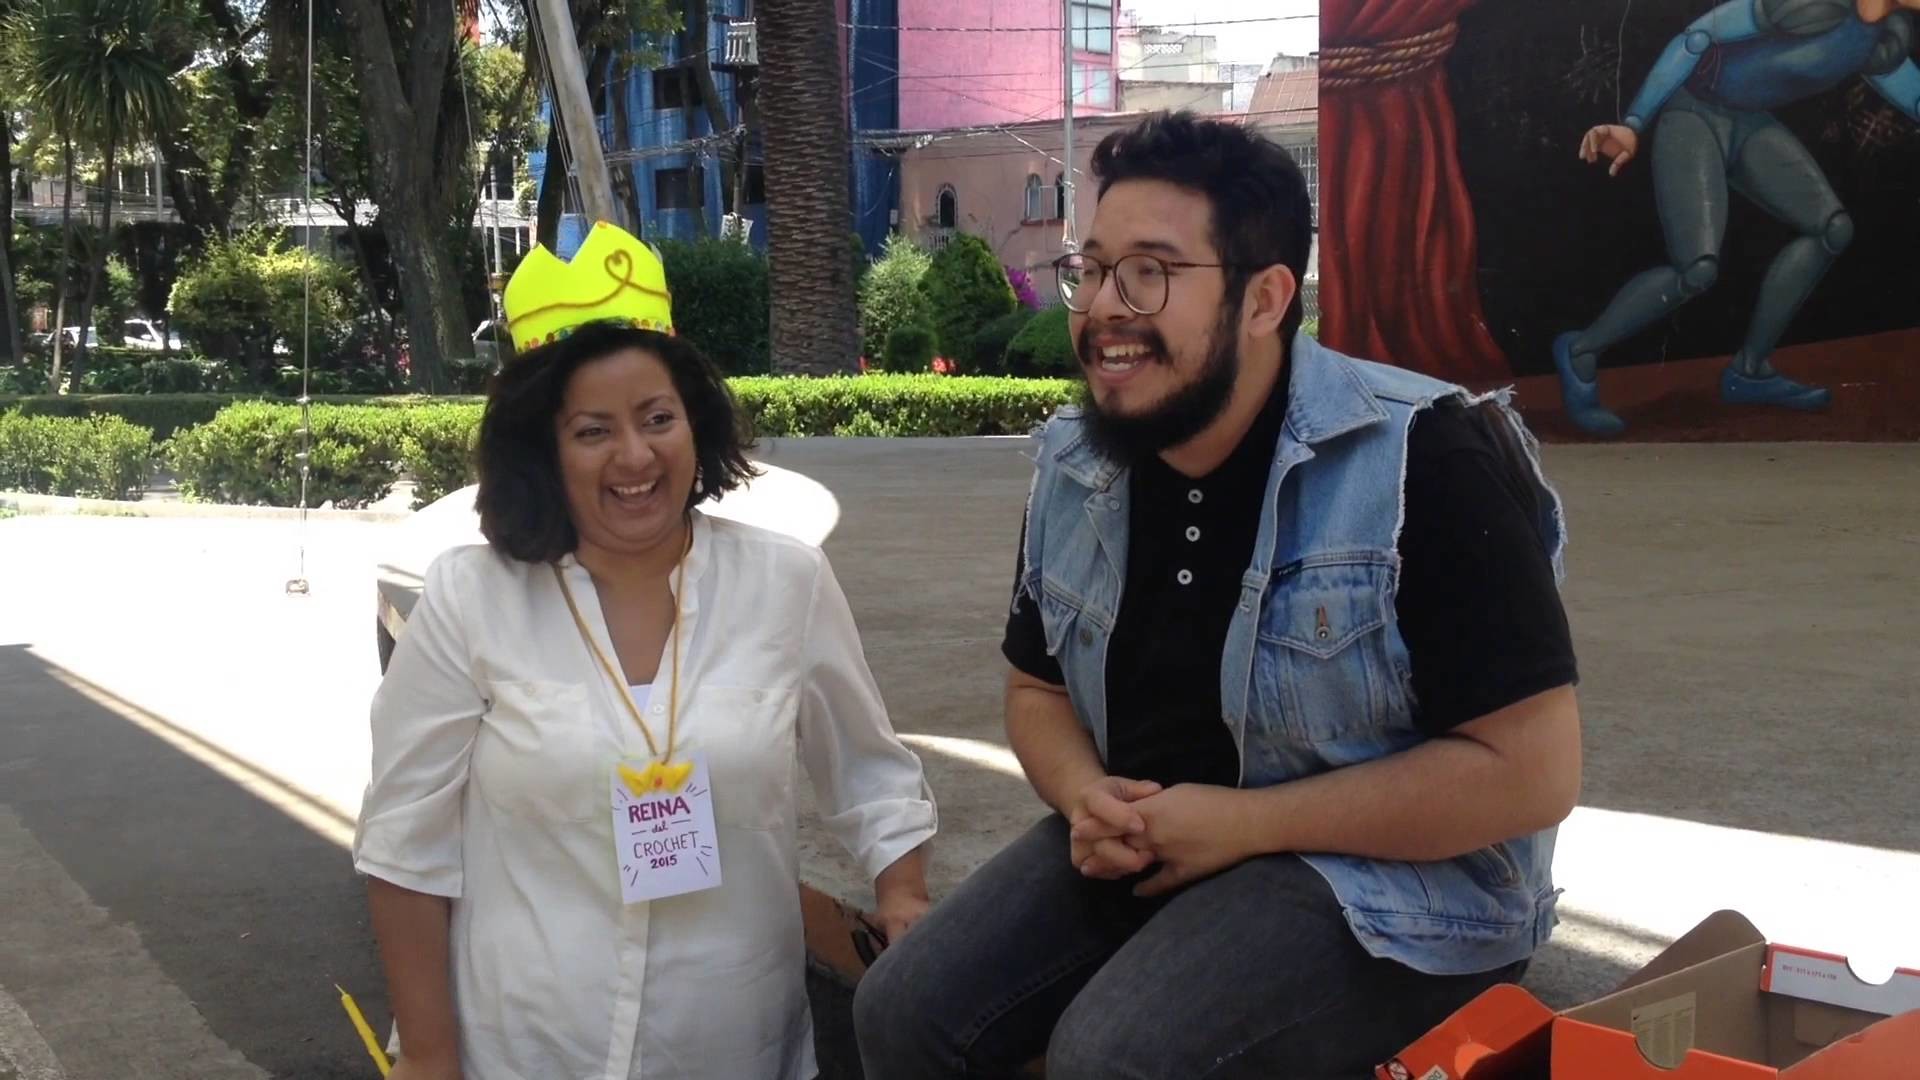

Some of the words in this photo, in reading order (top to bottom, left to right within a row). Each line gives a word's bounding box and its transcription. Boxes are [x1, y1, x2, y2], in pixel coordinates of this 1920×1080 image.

[628, 796, 691, 823] REINA
[652, 820, 669, 834] del
[633, 830, 699, 859] CROCHET
[650, 855, 678, 869] 2015
